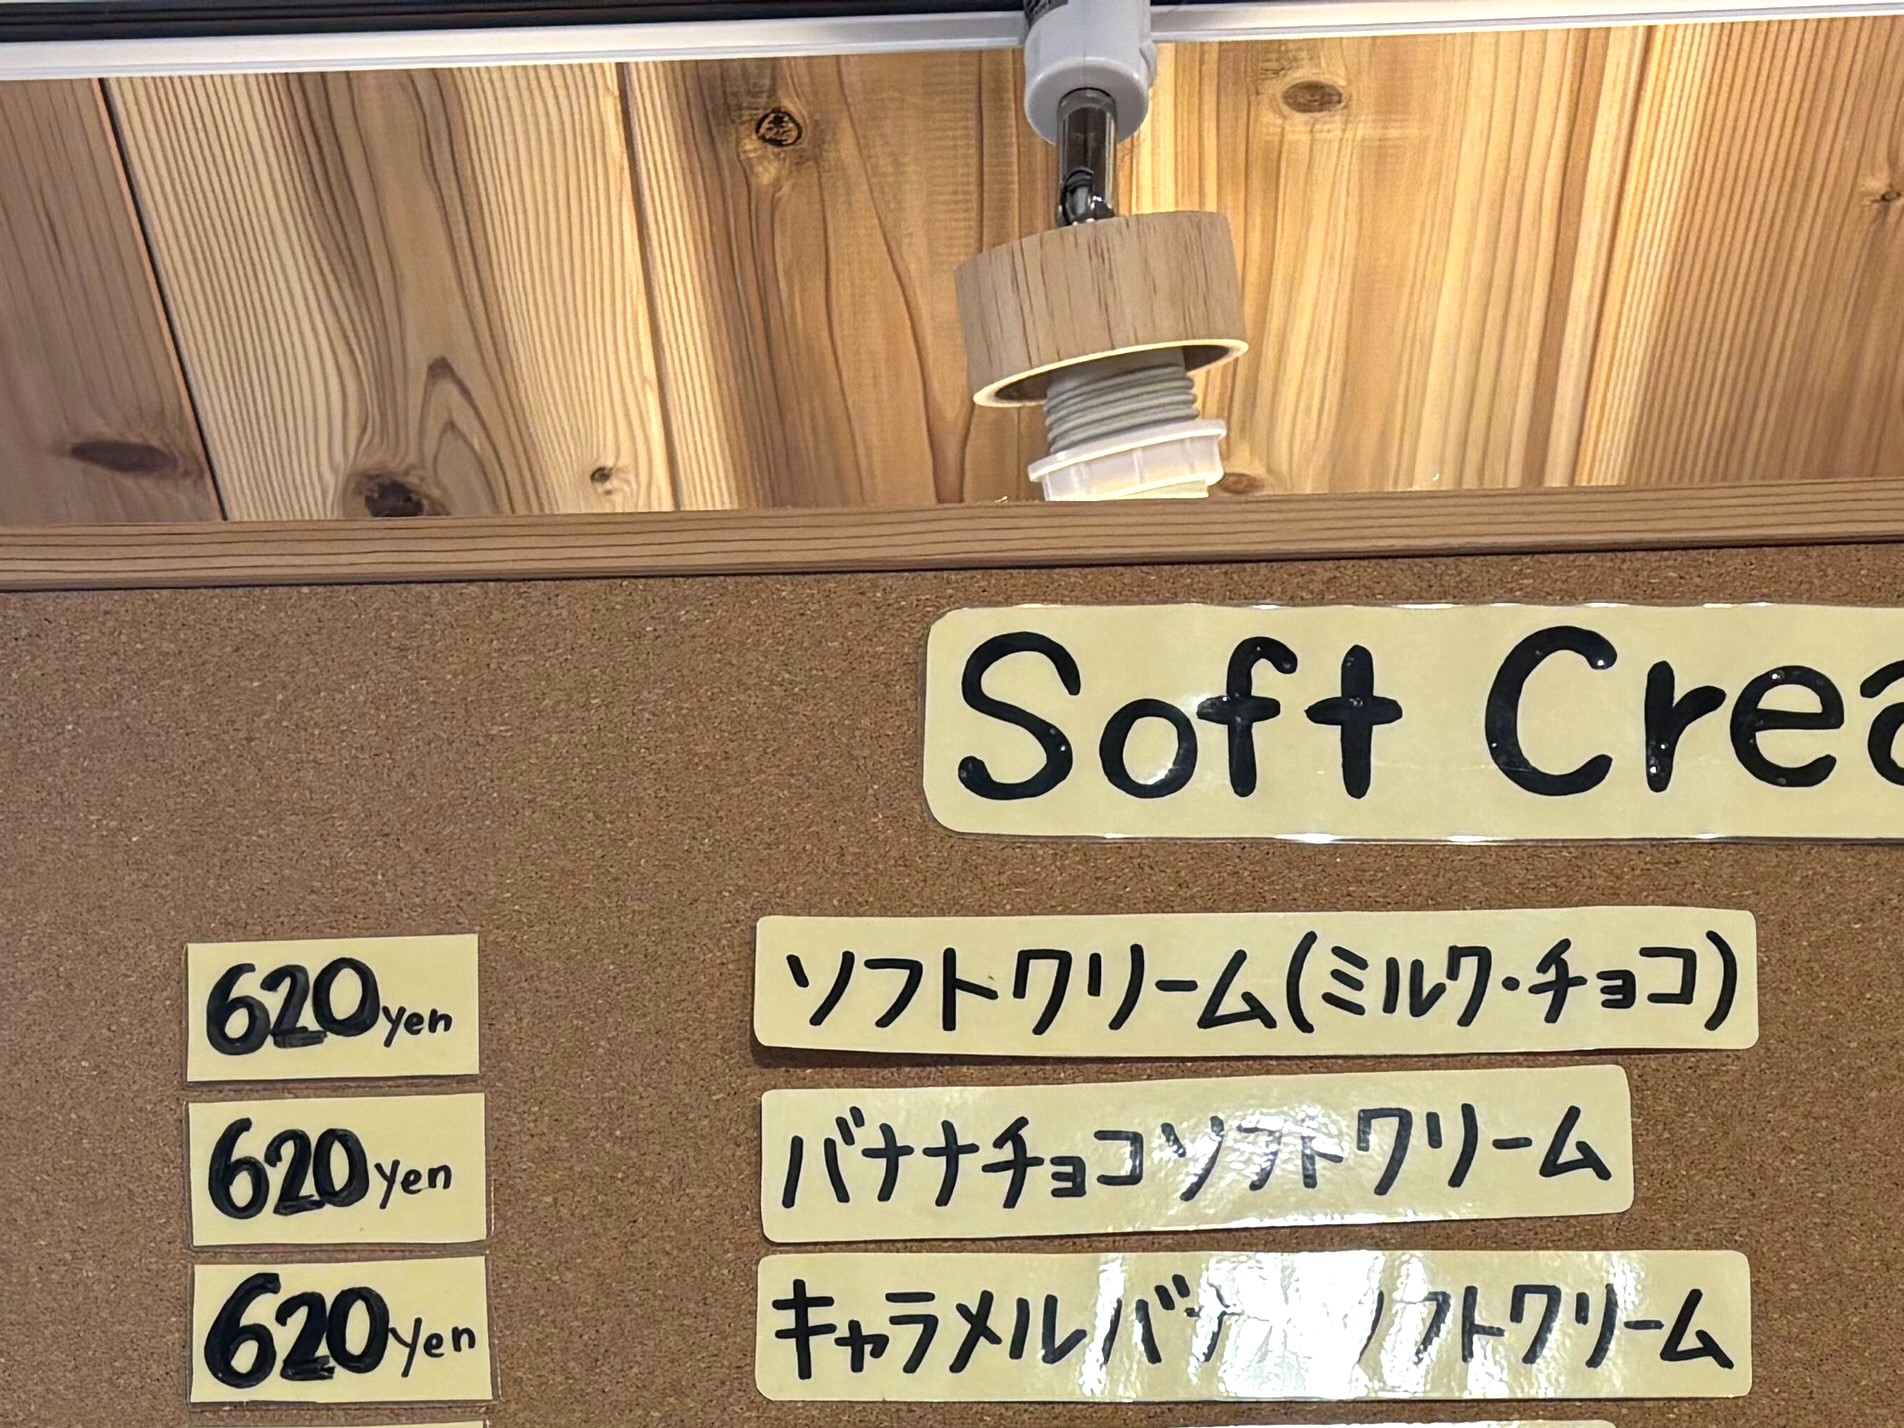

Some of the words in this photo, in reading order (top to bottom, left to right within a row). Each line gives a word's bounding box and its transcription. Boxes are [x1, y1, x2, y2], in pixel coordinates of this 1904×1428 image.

[957, 631, 1403, 801] Soft
[786, 930, 1738, 1036] ソフトクリーム(ミルク・チョコ)
[781, 1103, 1612, 1209] バナナチョコソフトクリーム
